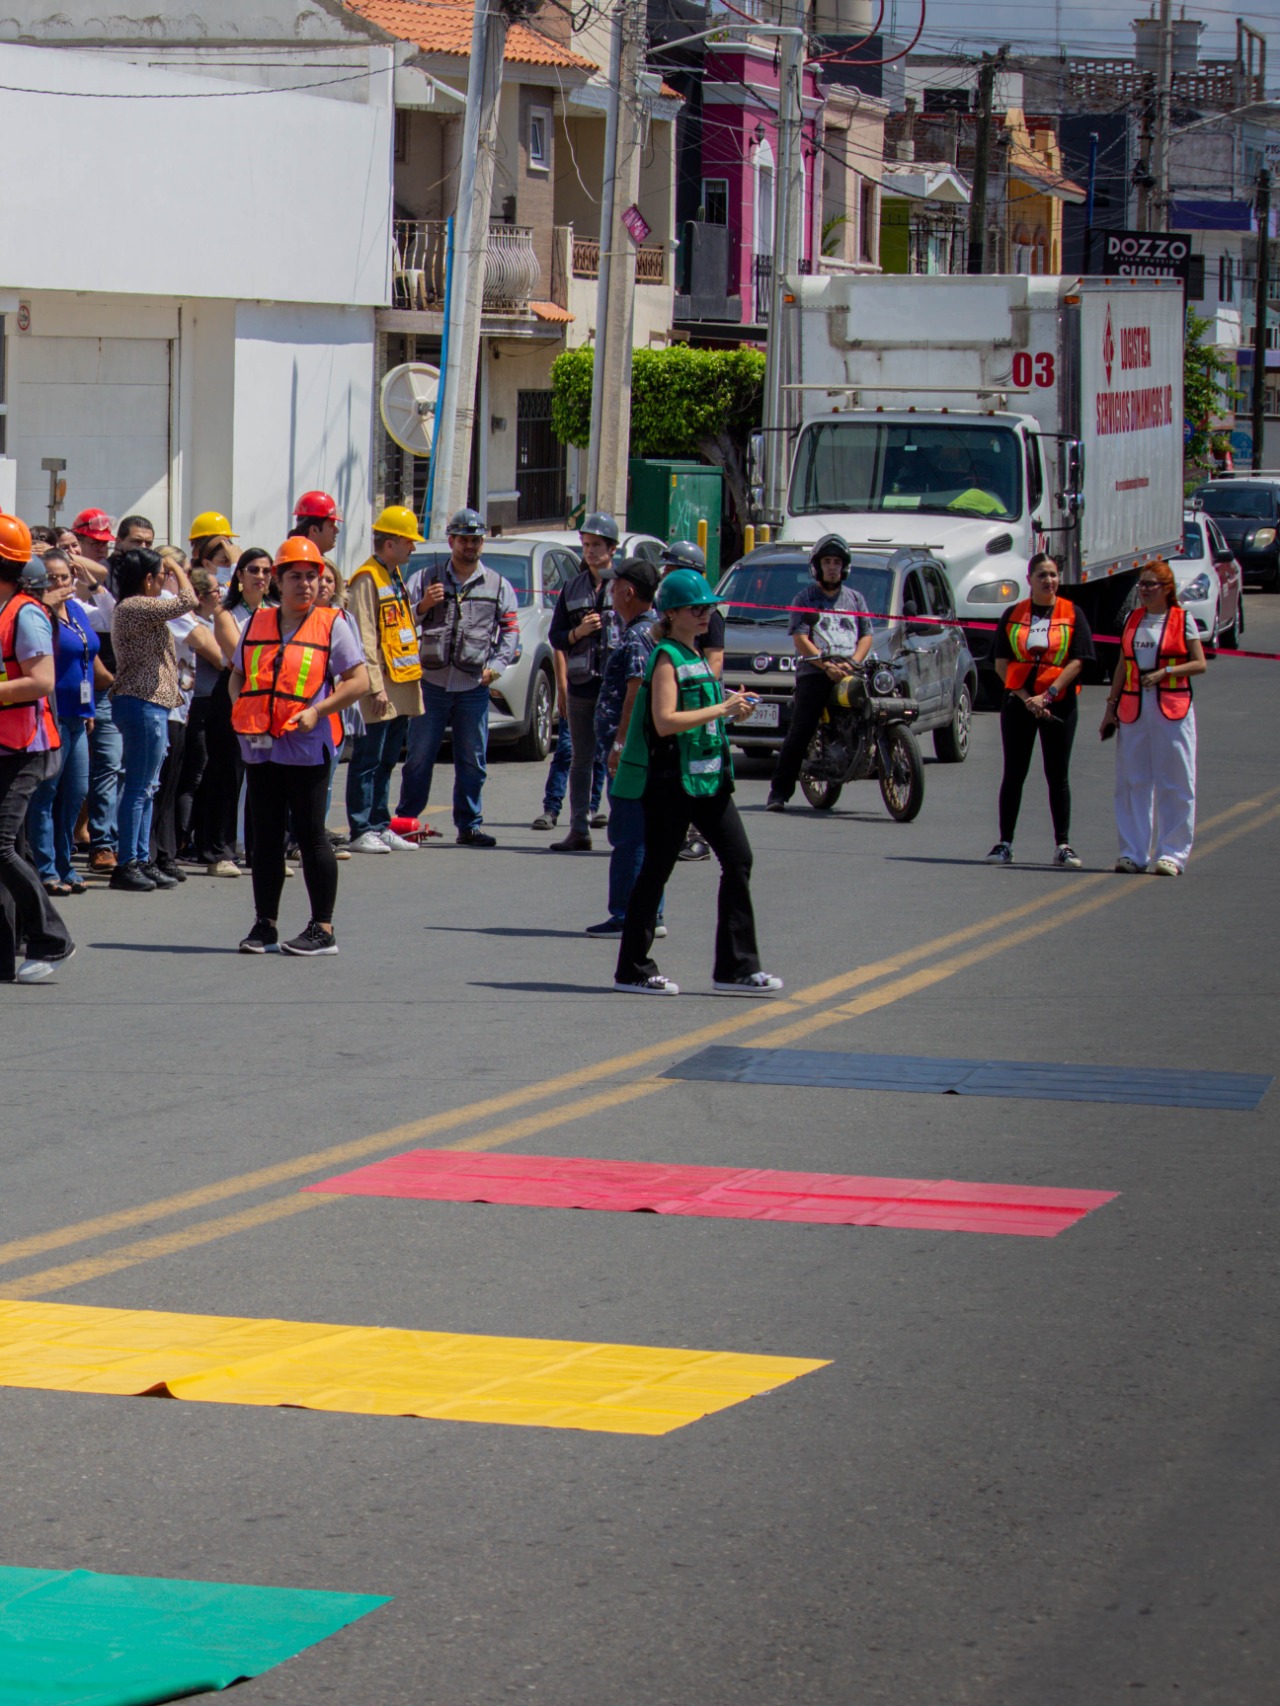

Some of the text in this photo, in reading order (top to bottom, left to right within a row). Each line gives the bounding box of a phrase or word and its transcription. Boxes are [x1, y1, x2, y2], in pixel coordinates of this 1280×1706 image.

[1107, 237, 1187, 260] DOZZO
[1121, 326, 1152, 370] LOGISTICA
[1012, 352, 1055, 388] 03
[1096, 391, 1130, 436] SERVICIOS
